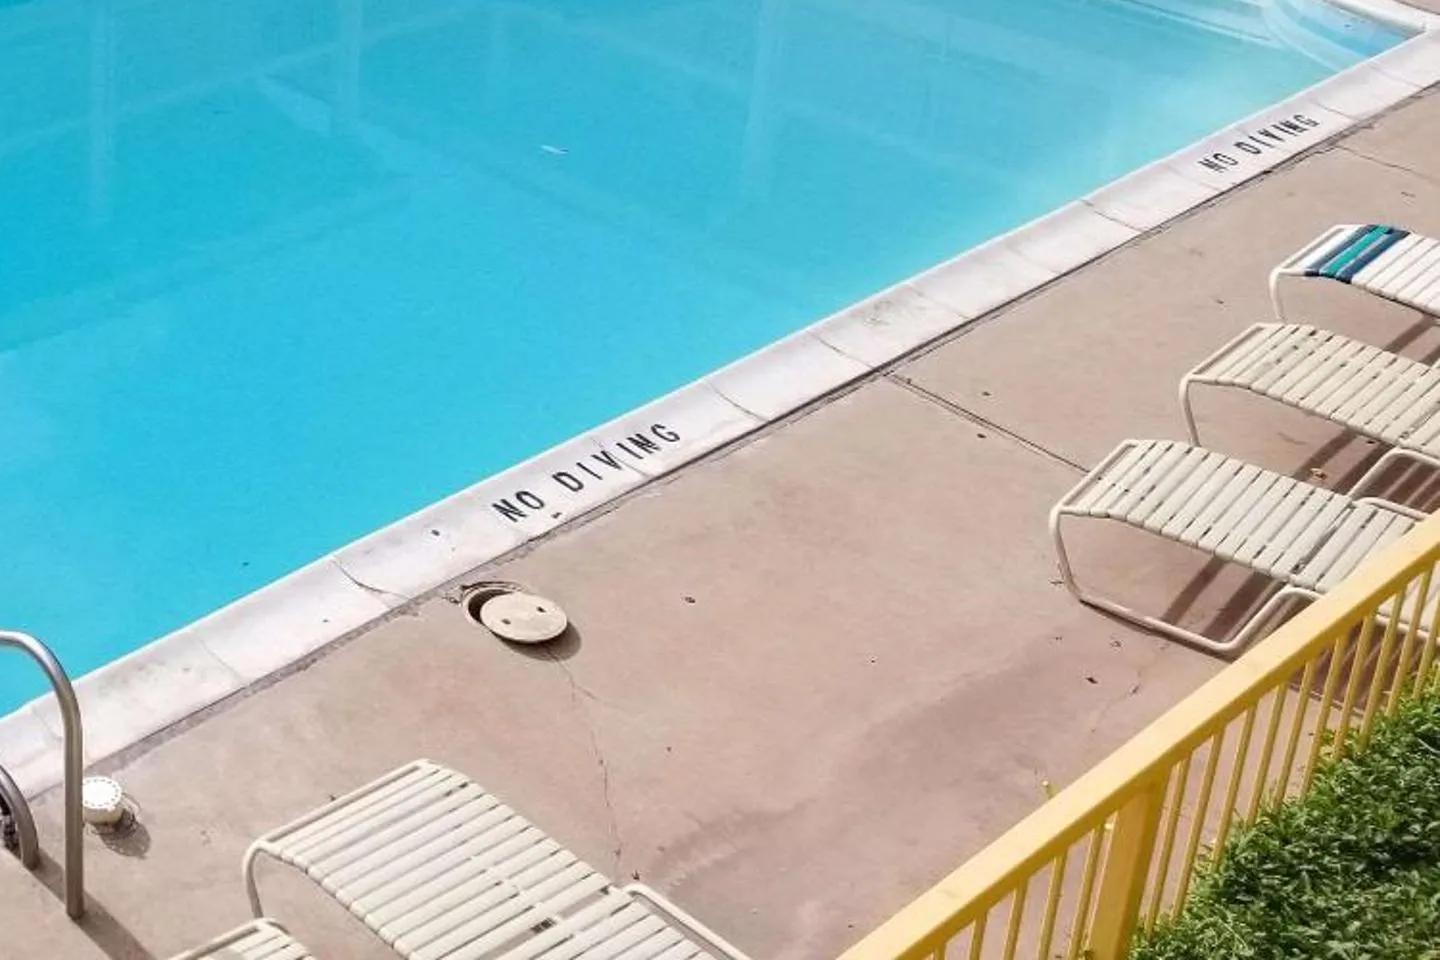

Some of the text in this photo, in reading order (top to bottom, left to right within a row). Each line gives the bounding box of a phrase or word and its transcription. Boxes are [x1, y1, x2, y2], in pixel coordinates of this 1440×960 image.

[1197, 114, 1320, 173] NO DIVING
[491, 423, 680, 522] NO DIVING
